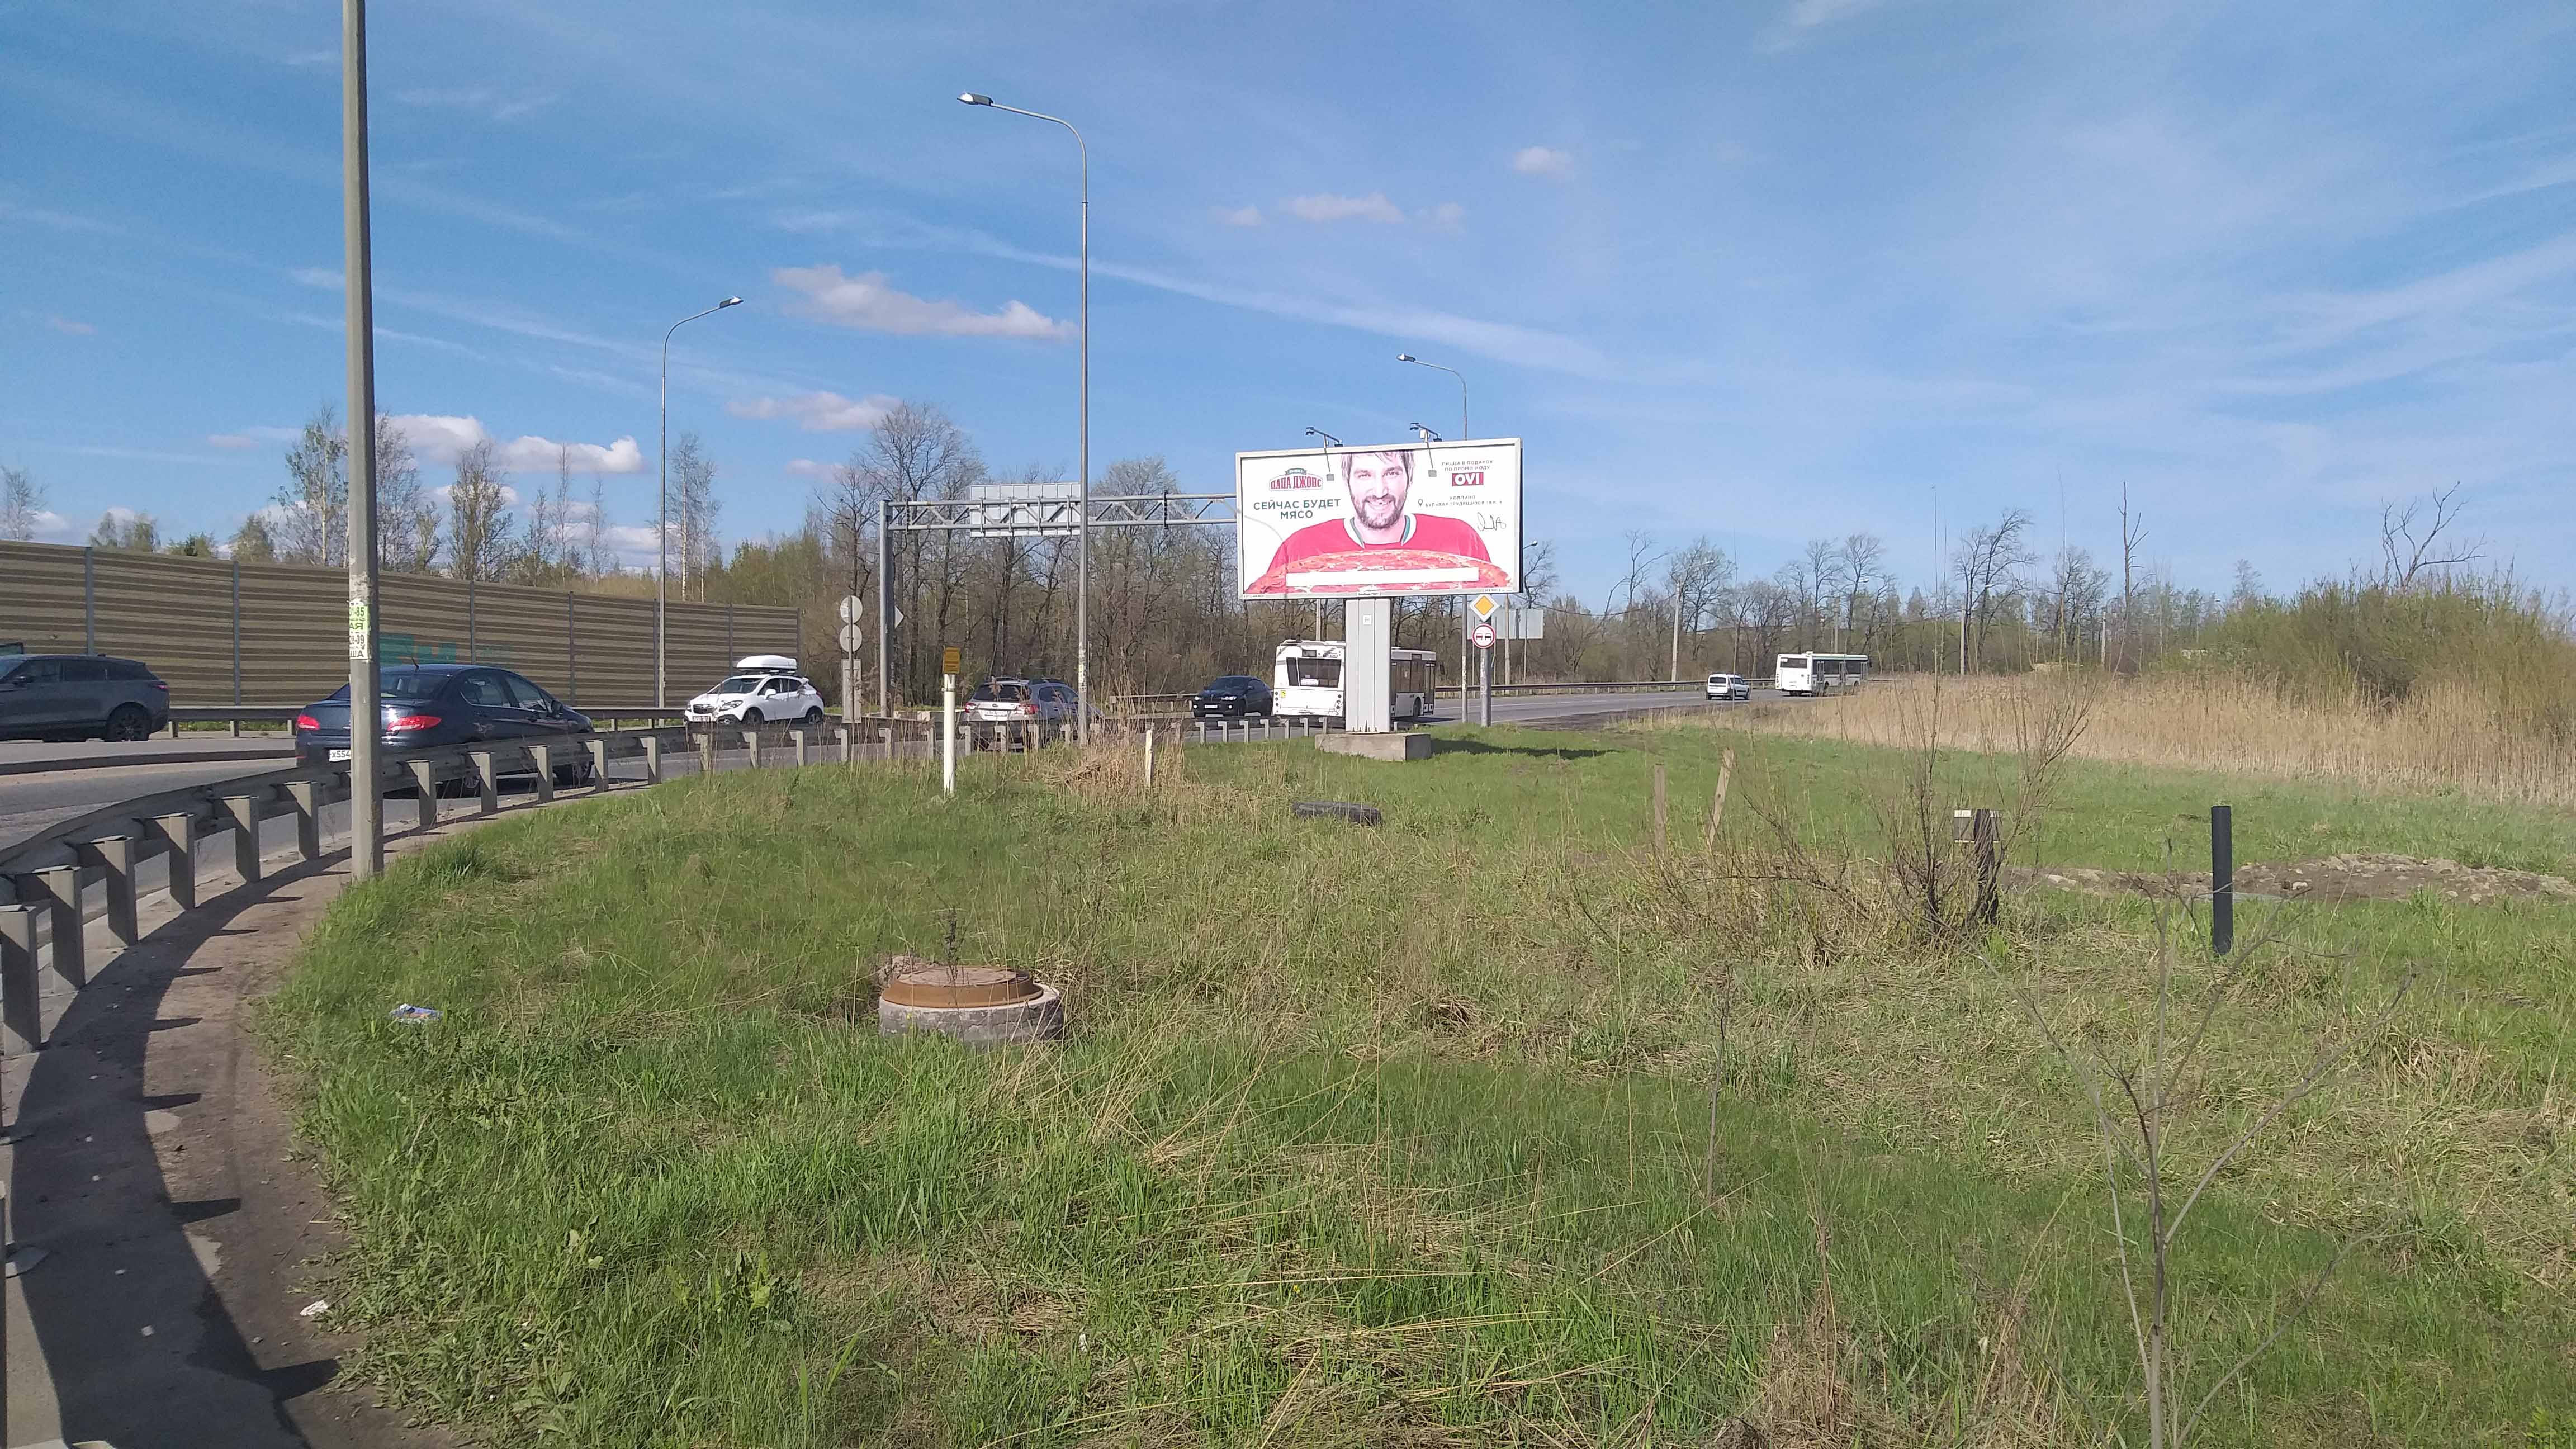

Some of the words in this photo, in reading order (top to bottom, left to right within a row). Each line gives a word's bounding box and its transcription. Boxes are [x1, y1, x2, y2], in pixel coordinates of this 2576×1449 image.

[1271, 476, 1291, 490] ПАПА
[1455, 473, 1480, 485] OVI
[1253, 499, 1299, 510] СЕЙЧАС
[1303, 499, 1341, 509] БУДЕТ
[1280, 510, 1313, 519] МЯСО
